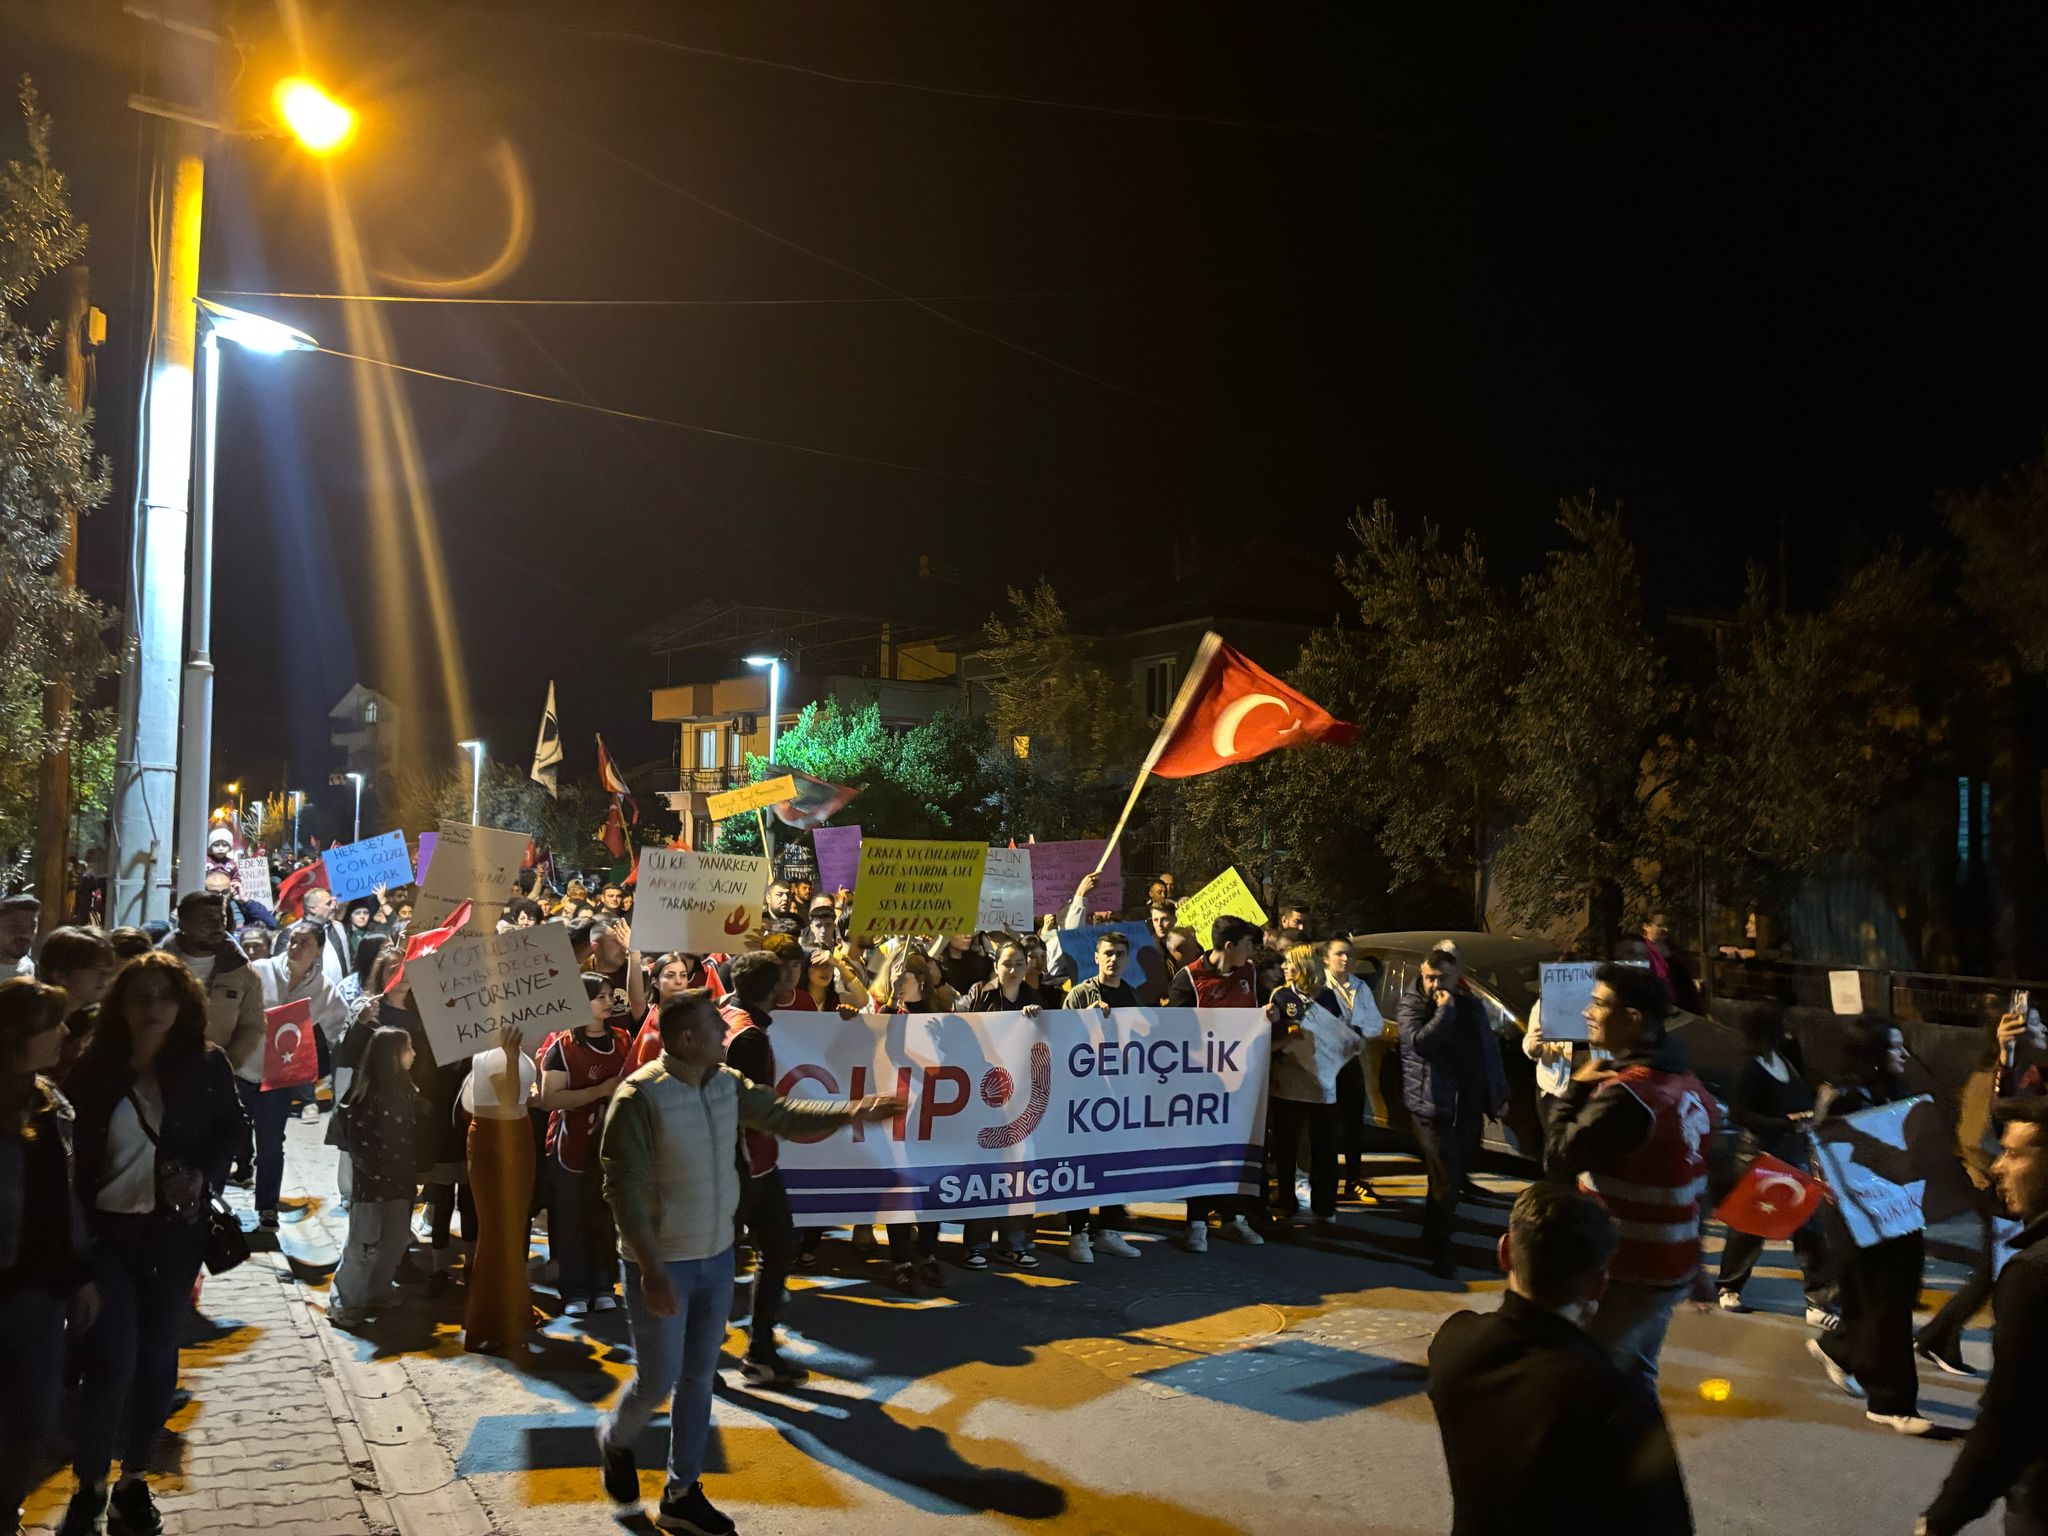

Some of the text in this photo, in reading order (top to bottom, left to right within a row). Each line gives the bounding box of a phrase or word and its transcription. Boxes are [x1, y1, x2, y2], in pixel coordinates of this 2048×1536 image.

[698, 855, 758, 872] YANARKEN
[867, 847, 902, 860] ERKEK
[869, 862, 896, 876] KÖTÜ
[901, 865, 948, 877] SANIRDIK
[953, 865, 973, 877] AMA
[346, 869, 400, 893] OLACAK
[894, 882, 907, 894] BU
[879, 899, 953, 912] SEN KAZANDIN
[866, 913, 965, 931] EMİNE!
[439, 952, 554, 994] KAYBEDECEK
[456, 998, 572, 1044] KAZANACAK
[775, 1031, 1241, 1144] CHP GENÇLİK
[1068, 1092, 1230, 1134] KOLLARI
[938, 1160, 1095, 1204] SARIGÖL
